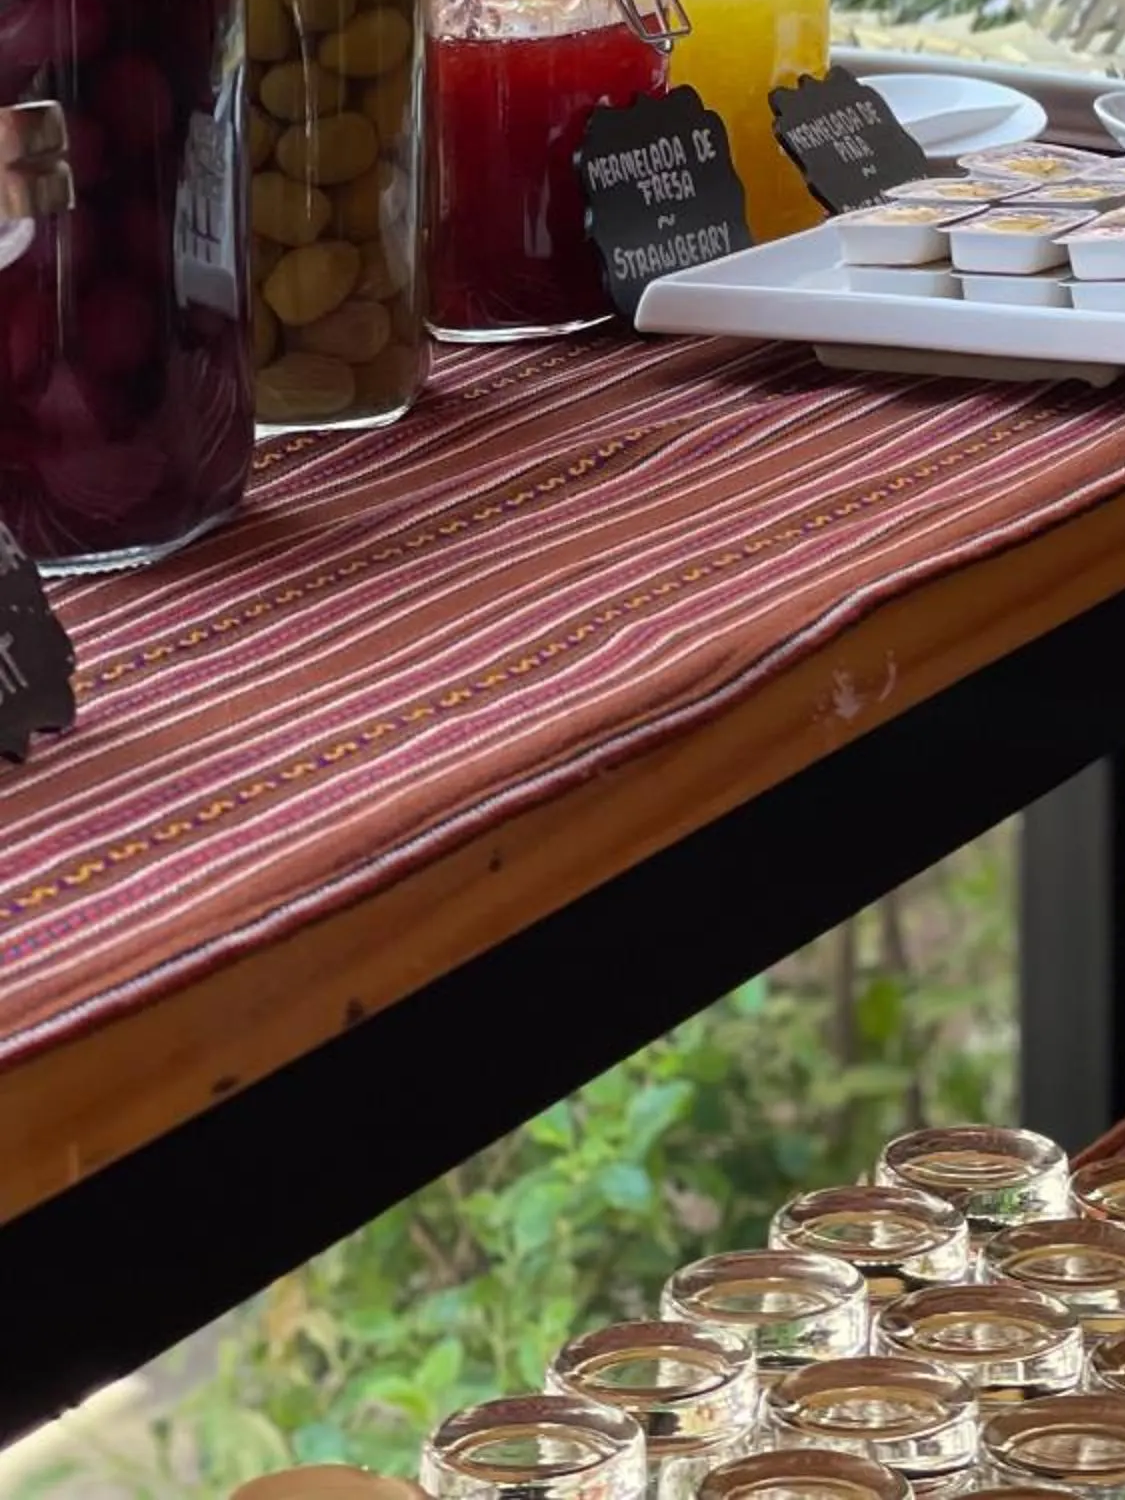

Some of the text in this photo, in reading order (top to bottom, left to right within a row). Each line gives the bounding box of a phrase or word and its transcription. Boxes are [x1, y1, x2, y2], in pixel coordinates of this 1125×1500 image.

[786, 101, 882, 155] MERMELADA DE
[587, 128, 717, 192] MERMELADA DE
[636, 169, 697, 206] FRESA
[613, 220, 732, 280] STRAWBERRY
